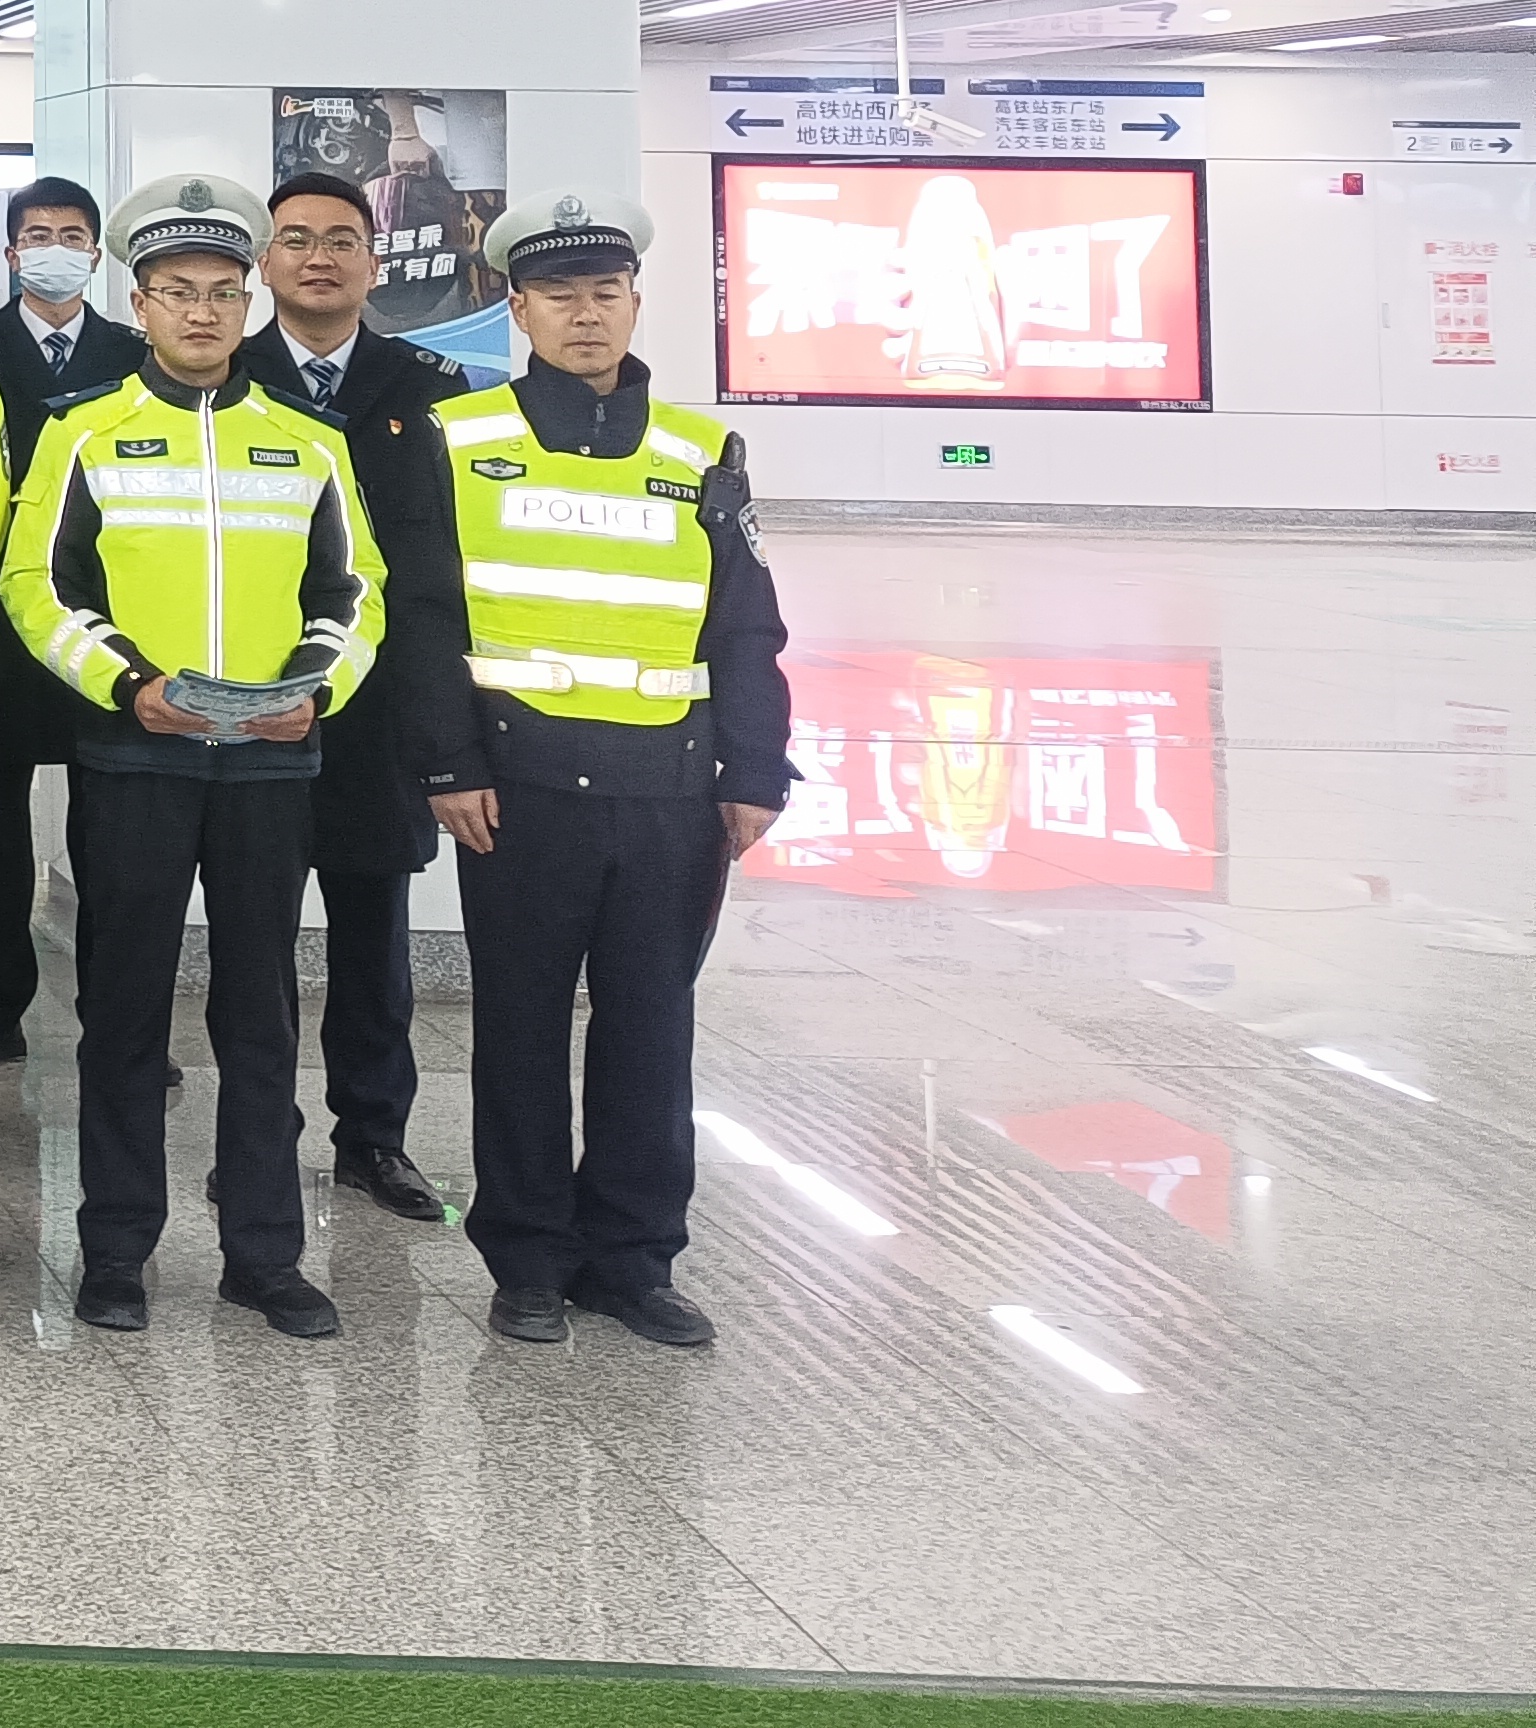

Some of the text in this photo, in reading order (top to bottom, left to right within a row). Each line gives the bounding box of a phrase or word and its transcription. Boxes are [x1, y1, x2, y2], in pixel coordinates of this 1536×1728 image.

[994, 99, 1105, 115] 高铁站东广场
[995, 117, 1106, 132] 汽车客运东站
[796, 126, 934, 147] 地铁进站购票
[995, 135, 1106, 150] 公交车始发站
[523, 496, 659, 531] POLICE
